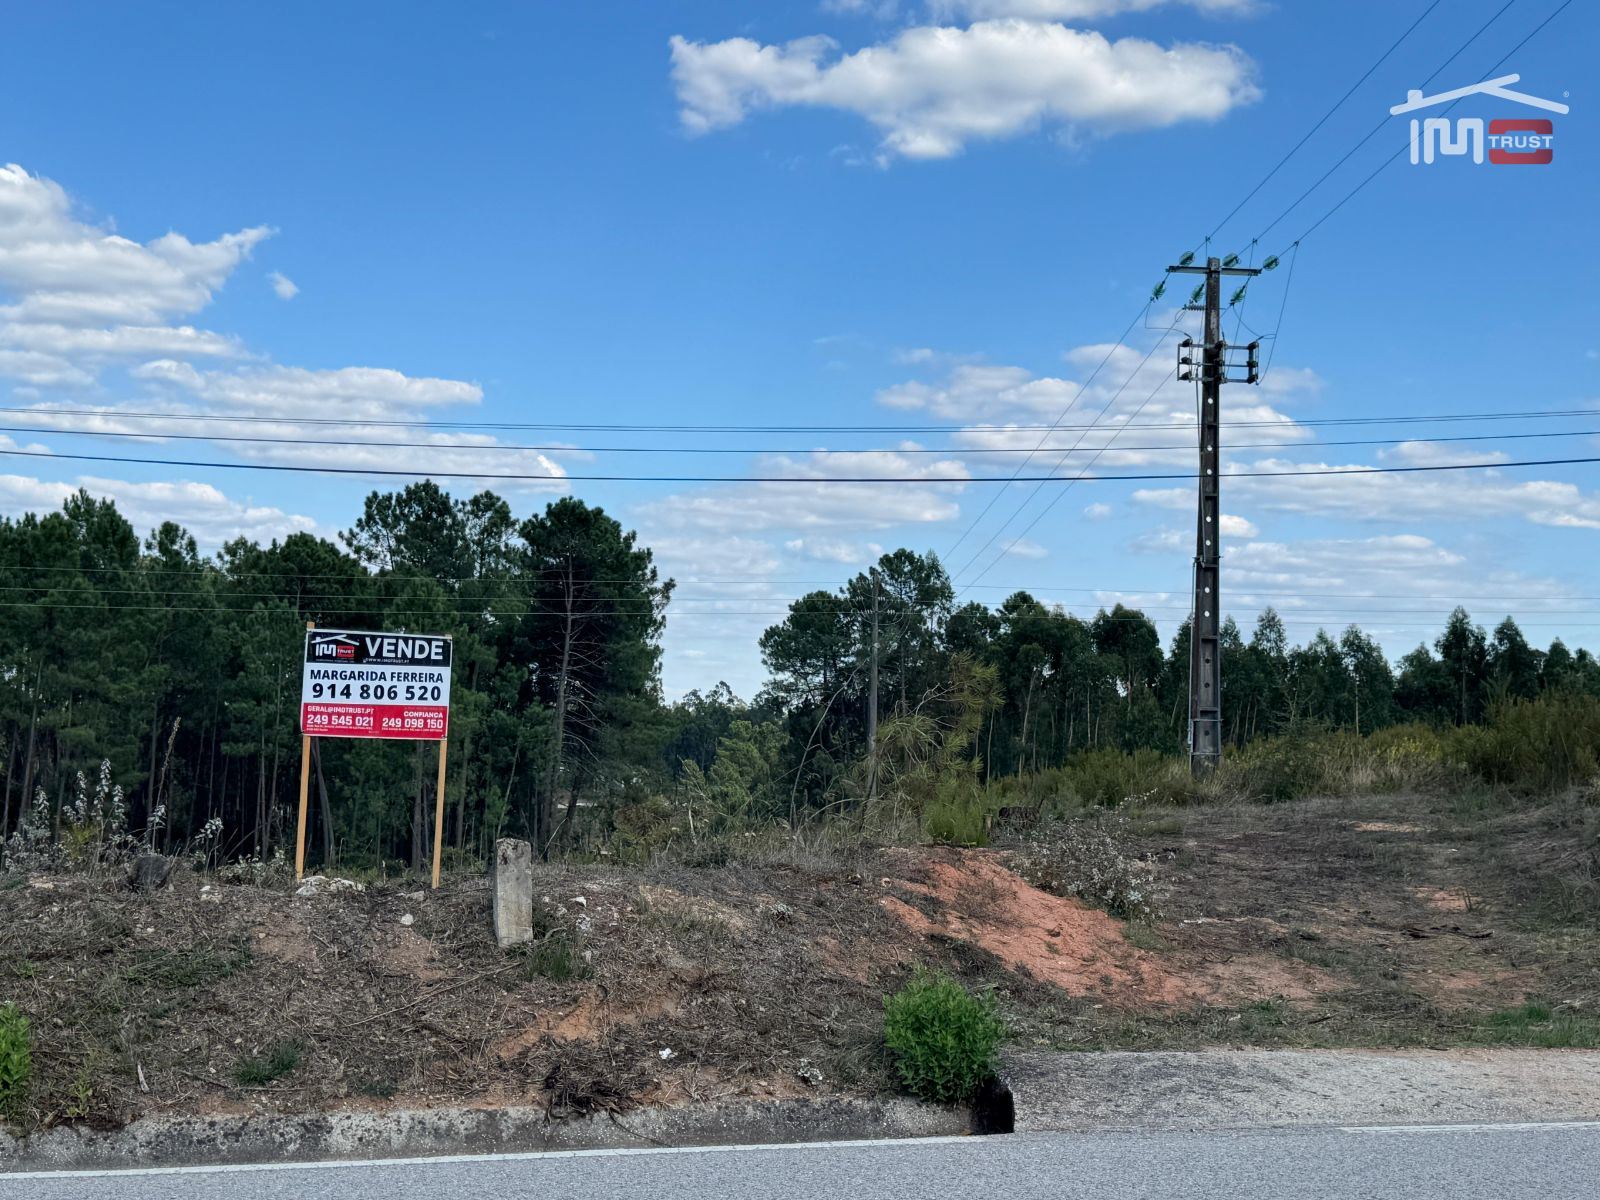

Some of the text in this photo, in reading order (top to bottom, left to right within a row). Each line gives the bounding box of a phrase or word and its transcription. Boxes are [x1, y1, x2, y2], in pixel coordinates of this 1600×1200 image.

[365, 637, 443, 660] VENDE
[310, 670, 443, 683] MARGARIDA FERREIRA
[312, 683, 441, 701] 914 806 520
[307, 715, 373, 726] 249 545 021
[382, 717, 402, 728] 249
[404, 718, 424, 728] 098
[426, 719, 443, 729] 150
